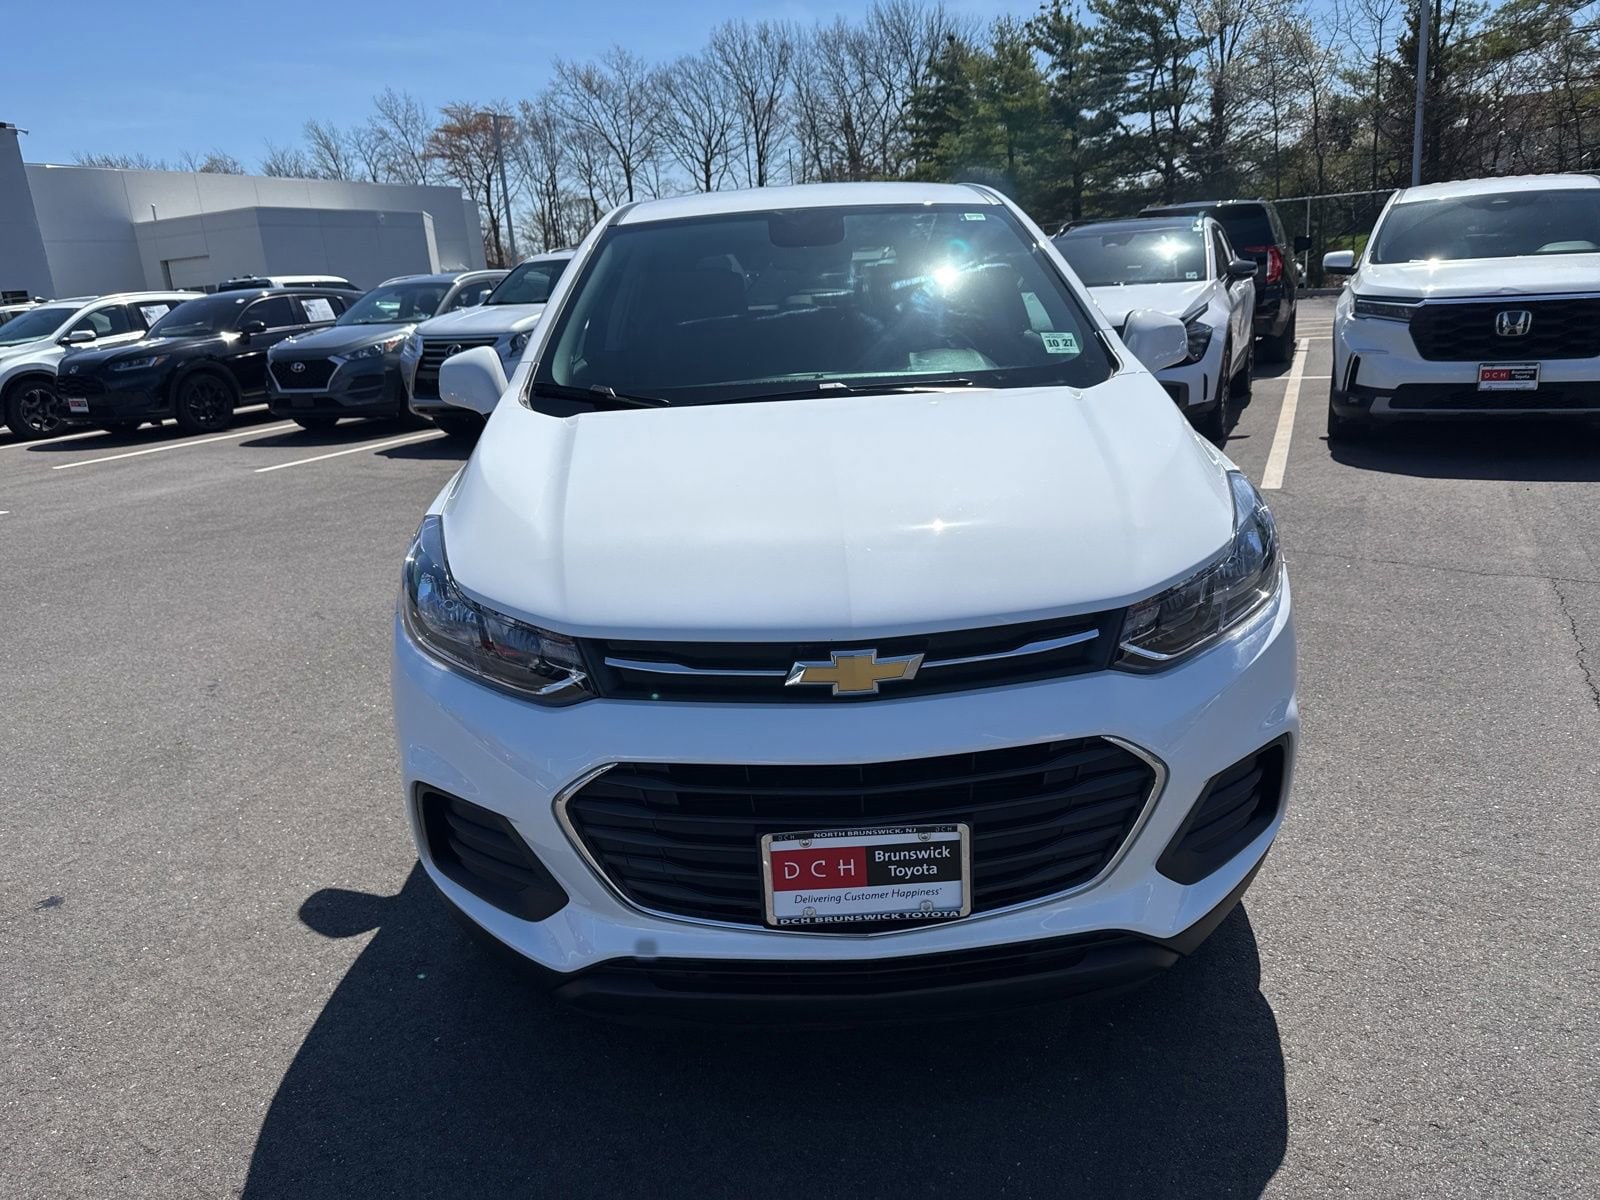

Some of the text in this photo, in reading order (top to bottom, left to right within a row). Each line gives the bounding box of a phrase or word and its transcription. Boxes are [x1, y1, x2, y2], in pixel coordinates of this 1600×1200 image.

[1046, 338, 1073, 347] 10 27
[874, 846, 951, 862] Brunswick
[888, 864, 938, 879] Toyota
[794, 893, 842, 905] Delivering
[844, 891, 888, 901] Customer
[780, 917, 811, 925] DCH
[815, 912, 900, 923] BRUNSWICK
